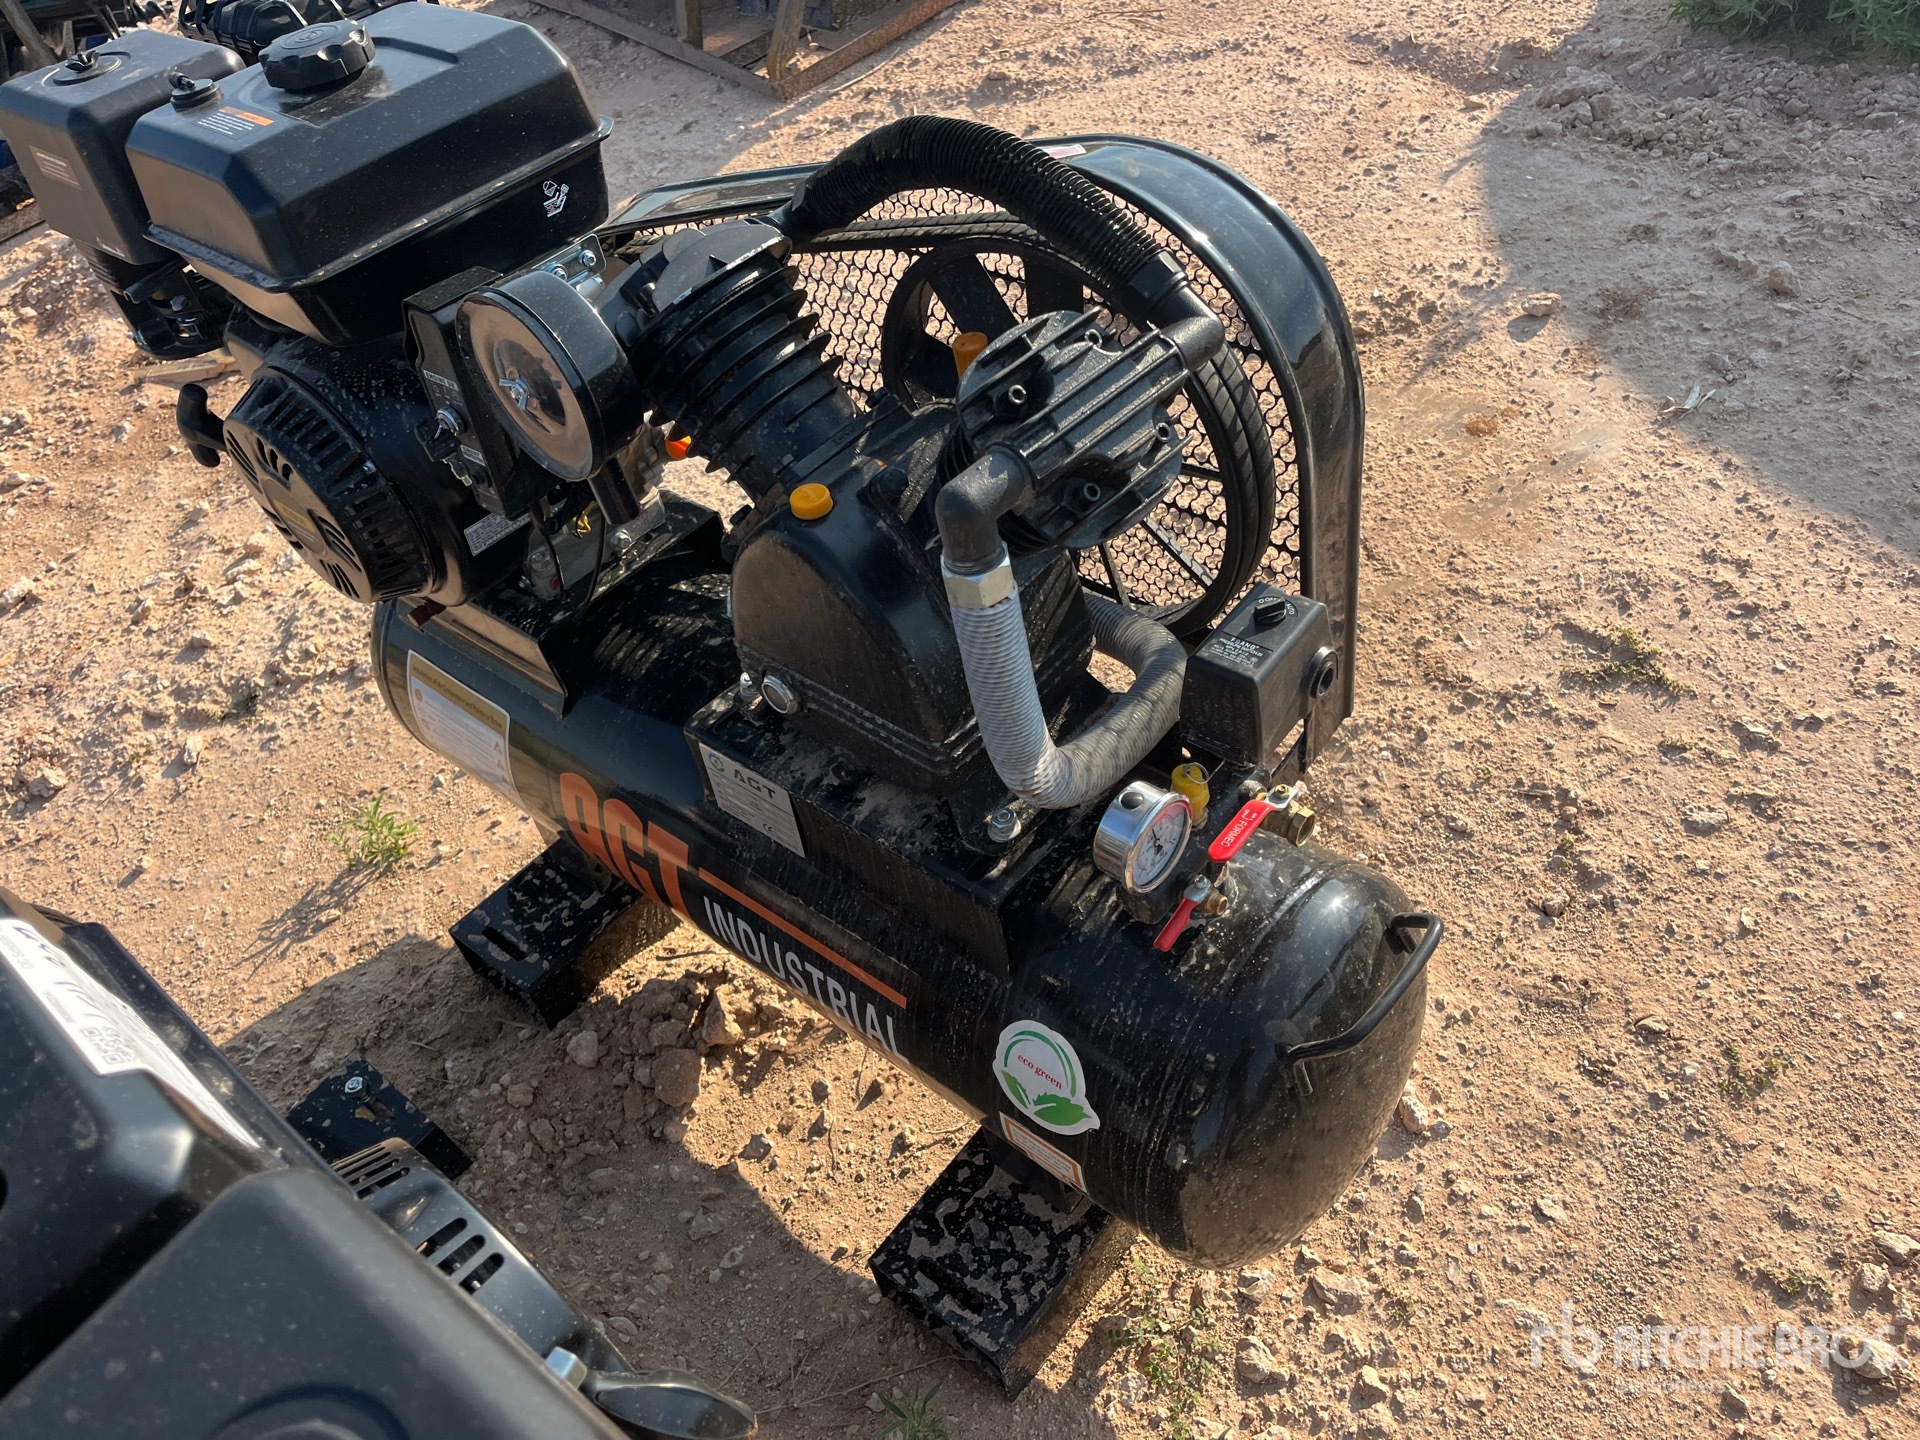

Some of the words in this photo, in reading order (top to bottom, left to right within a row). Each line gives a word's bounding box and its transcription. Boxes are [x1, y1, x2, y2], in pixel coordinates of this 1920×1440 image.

[733, 768, 776, 800] AGT
[704, 896, 909, 1065] INDUSTRIAL
[1018, 1054, 1034, 1069] eco
[1035, 1067, 1062, 1089] green
